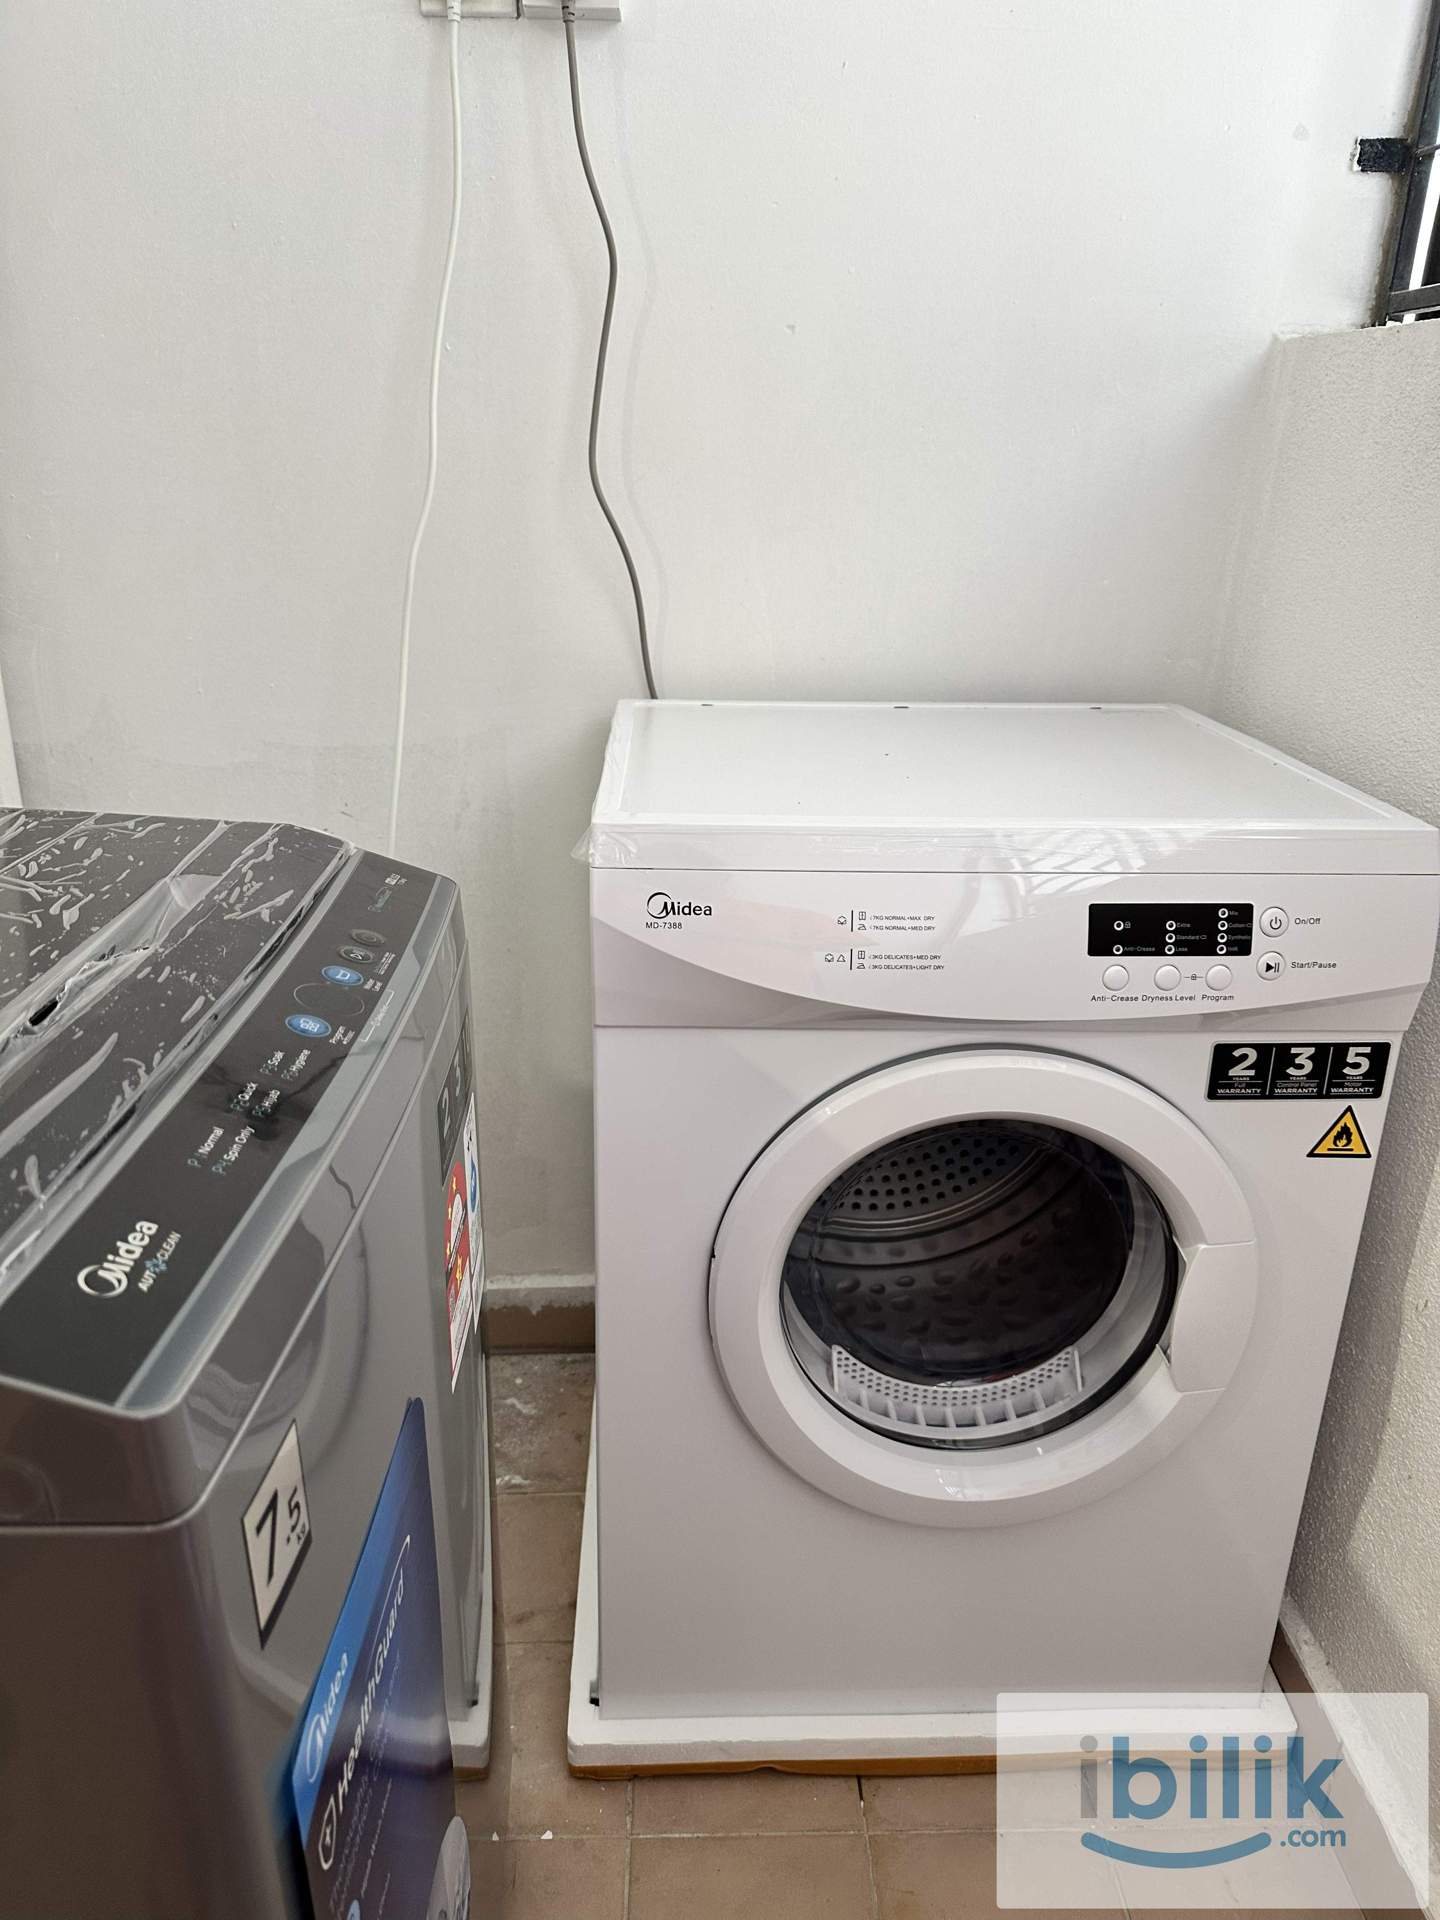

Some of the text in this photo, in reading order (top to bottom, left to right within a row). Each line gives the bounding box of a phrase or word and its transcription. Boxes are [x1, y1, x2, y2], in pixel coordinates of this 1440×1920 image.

[646, 892, 712, 920] Midea
[645, 921, 683, 930] MD-7388
[1294, 917, 1321, 925] On/Off
[1290, 961, 1337, 969] Start/Pause
[1090, 994, 1139, 1002] Anti-Crease
[1141, 994, 1173, 1003] Dryness
[1201, 994, 1235, 1003] Program
[1228, 1047, 1257, 1076] 2
[1285, 1047, 1315, 1076] 3
[1342, 1046, 1372, 1076] 5
[238, 1081, 258, 1101] Quick
[262, 1089, 280, 1108] Hijab
[198, 1126, 225, 1156] Normal
[223, 1142, 243, 1162] Spin
[235, 1126, 256, 1144] Only
[77, 1220, 159, 1298] Midea
[337, 1567, 404, 1816] HealthGuard
[306, 1652, 348, 1783] Midea
